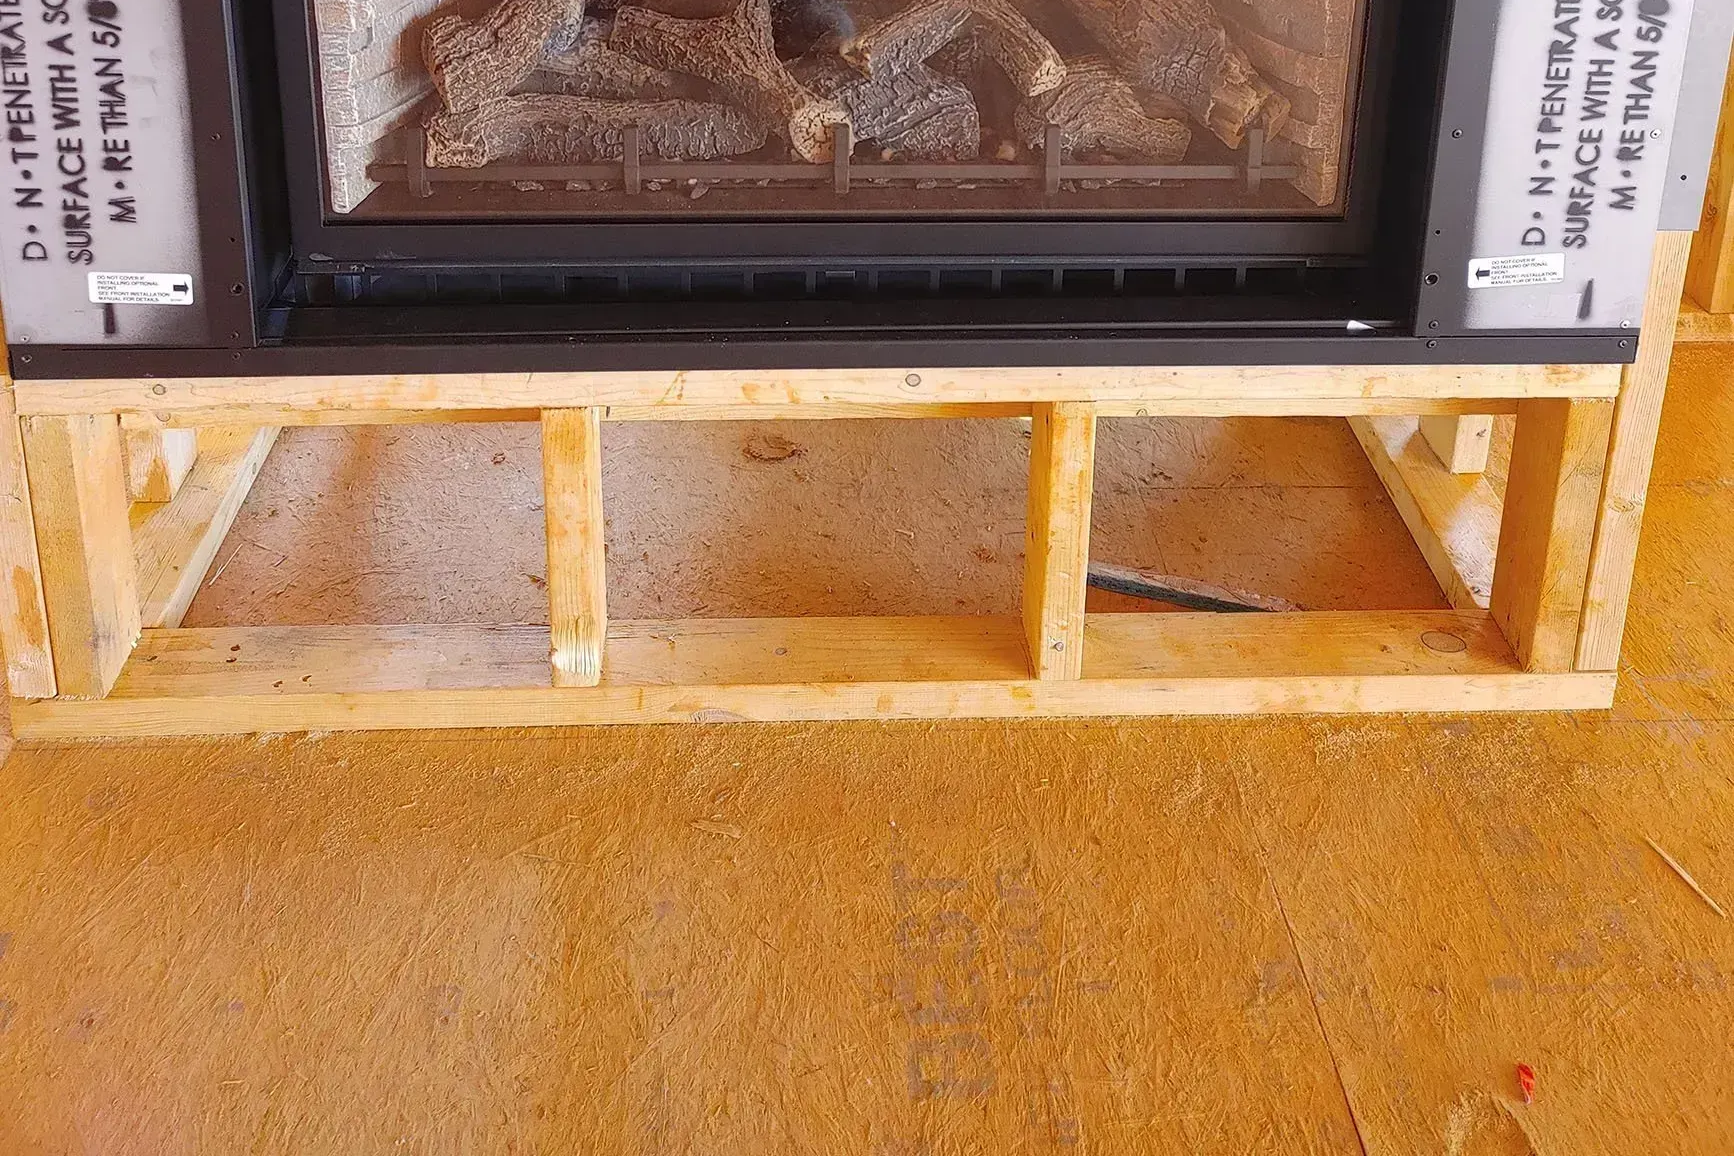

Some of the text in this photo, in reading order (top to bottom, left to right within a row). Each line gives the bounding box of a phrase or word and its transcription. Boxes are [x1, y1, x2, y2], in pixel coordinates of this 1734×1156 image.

[45, 31, 75, 57] A
[1593, 28, 1621, 52] A
[47, 64, 81, 131] WITH
[92, 57, 129, 135] THAN
[1579, 59, 1616, 122] WITH
[1622, 50, 1660, 126] THAN
[56, 137, 94, 266] SURFACE
[1561, 128, 1603, 250] SURFACE
